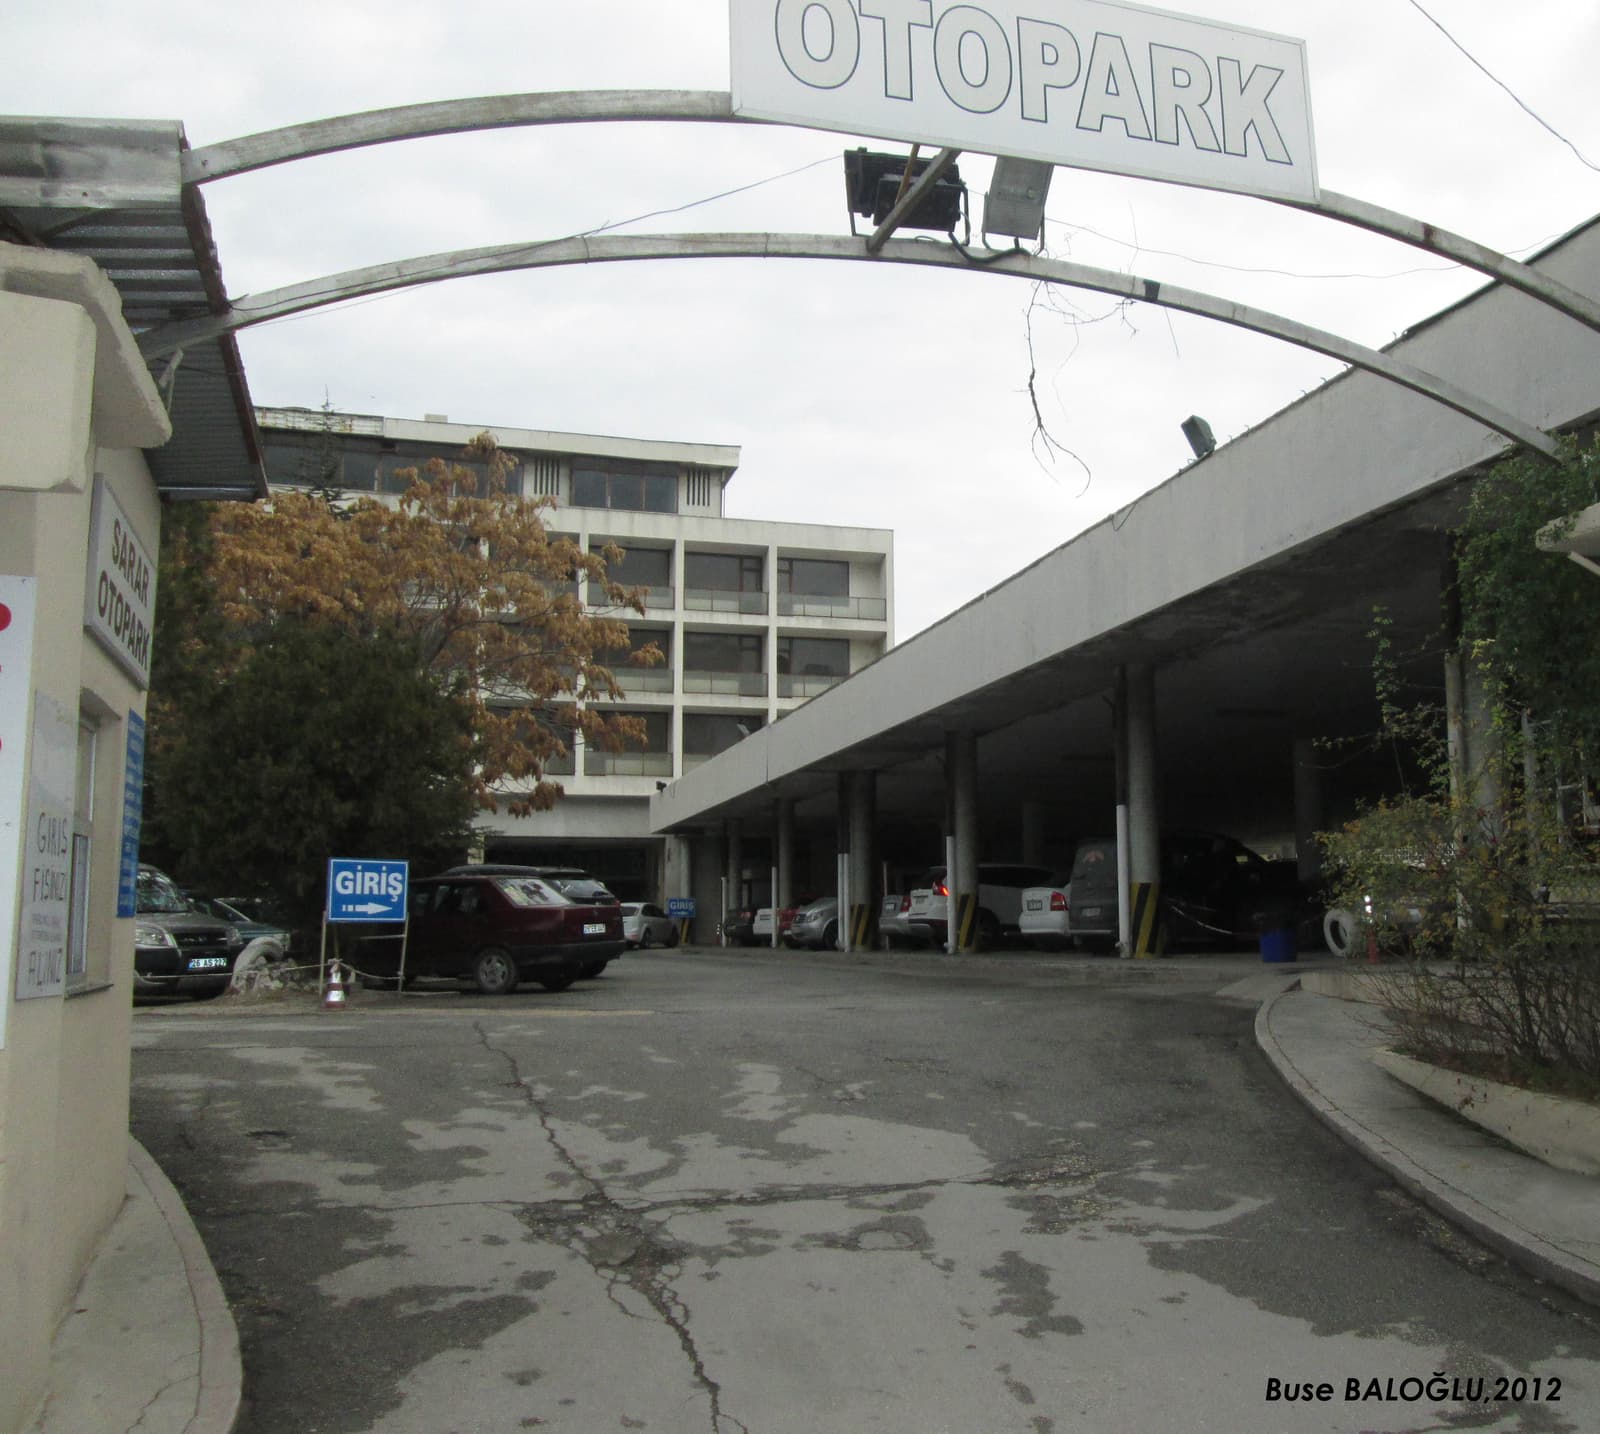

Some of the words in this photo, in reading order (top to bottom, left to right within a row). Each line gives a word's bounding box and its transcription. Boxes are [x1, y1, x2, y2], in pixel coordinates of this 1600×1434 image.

[774, 0, 1293, 166] OTOPARK
[112, 517, 149, 608] SARAR
[98, 569, 149, 671] OTOPARK
[335, 865, 403, 902] GİRİŞ
